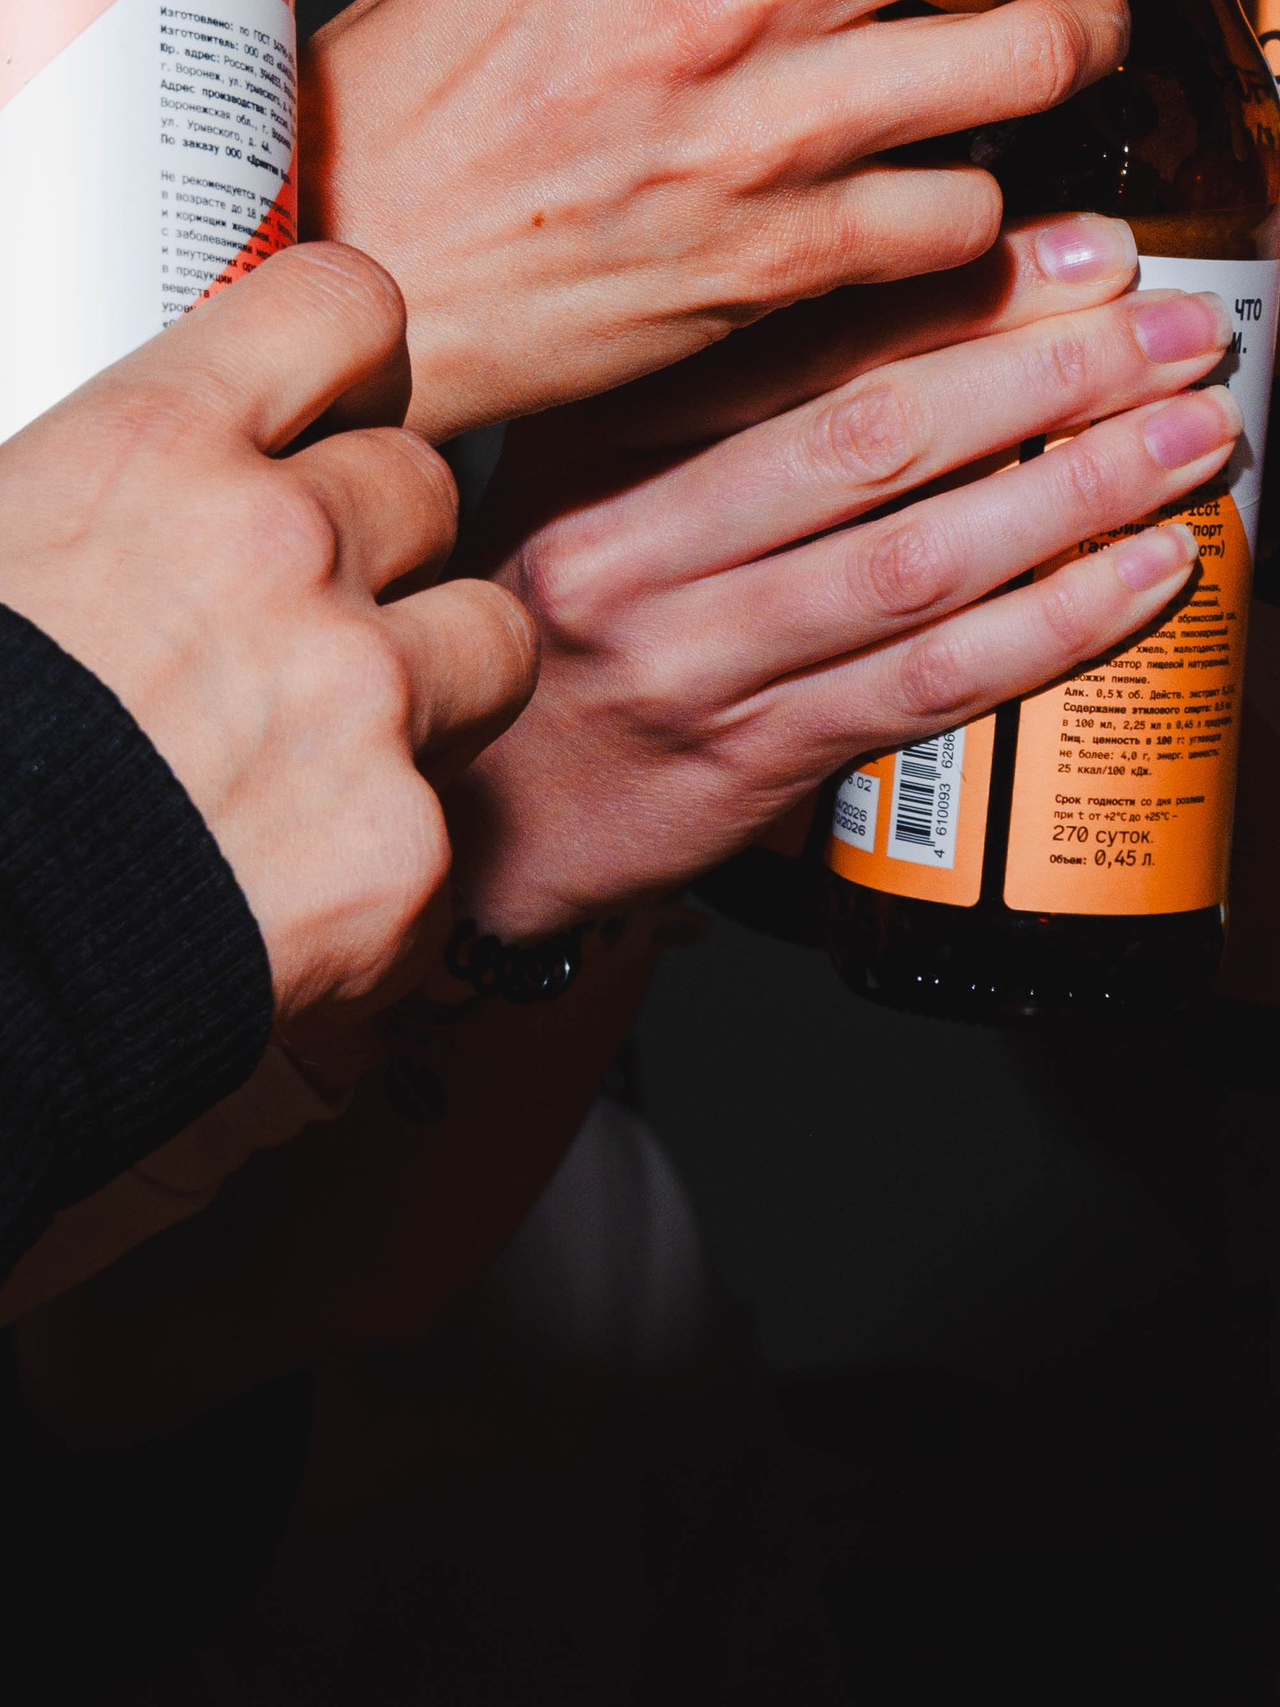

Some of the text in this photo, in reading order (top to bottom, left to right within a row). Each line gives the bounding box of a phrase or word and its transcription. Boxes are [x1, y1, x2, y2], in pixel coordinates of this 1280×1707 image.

[160, 5, 270, 45] Изготовлено: по ГОСТ
[160, 24, 239, 51] Изготовитель:
[160, 43, 180, 55] Юр.
[185, 47, 220, 64] адрес:
[224, 54, 257, 77] Россия,
[161, 61, 171, 72] г.
[176, 62, 225, 84] Воронеж,
[228, 76, 243, 88] ул.
[160, 79, 196, 94] Адрес
[202, 87, 268, 116] производства:
[161, 97, 231, 120] Воронежская
[161, 116, 179, 129] ул.
[187, 119, 243, 144] Урывского,
[161, 134, 175, 146] По
[182, 138, 220, 155] заказу
[161, 170, 256, 201] Не рекомендуется
[176, 191, 227, 210] возрасте
[231, 203, 243, 214] до
[247, 208, 257, 220] 18
[176, 212, 227, 229] кормящим
[176, 231, 253, 255] заболеваниями
[176, 248, 237, 268] внутренних
[176, 266, 232, 284] продукции
[162, 283, 210, 299] веществ
[162, 301, 196, 314] уров
[1235, 297, 1262, 321] ЧТО
[1136, 645, 1169, 655] хмель,
[1147, 659, 1184, 670] пищевой
[1111, 675, 1150, 685] пивные.
[1064, 687, 1090, 698] Алк.
[1128, 689, 1144, 700] об.
[1149, 689, 1185, 701] Действ.
[1063, 702, 1127, 715] Содержание
[1132, 705, 1180, 715] этилового
[1075, 718, 1095, 728] 100
[1100, 720, 1117, 730] мл,
[1123, 720, 1146, 731] 2,25
[1150, 722, 1162, 730] мл
[1060, 733, 1085, 744] Пищ.
[1092, 735, 1140, 745] ценность
[1156, 735, 1172, 745] 100
[1059, 749, 1073, 758] не
[1078, 749, 1114, 760] более:
[1120, 750, 1138, 761] 4,0
[1157, 752, 1184, 762] энерг.
[1058, 764, 1152, 777] 25 ккал/100 кДж.
[936, 783, 952, 836] 610093
[1055, 794, 1081, 807] Срок
[1087, 796, 1136, 807] годности
[1141, 798, 1152, 807] со
[1156, 798, 1172, 808] дня
[1053, 810, 1074, 821] при
[1088, 812, 1102, 821] от
[1129, 813, 1141, 822] до
[1052, 825, 1155, 848] 270 суток.
[934, 849, 945, 858] 4
[1049, 849, 1156, 869] Объем: 0,45 л.
